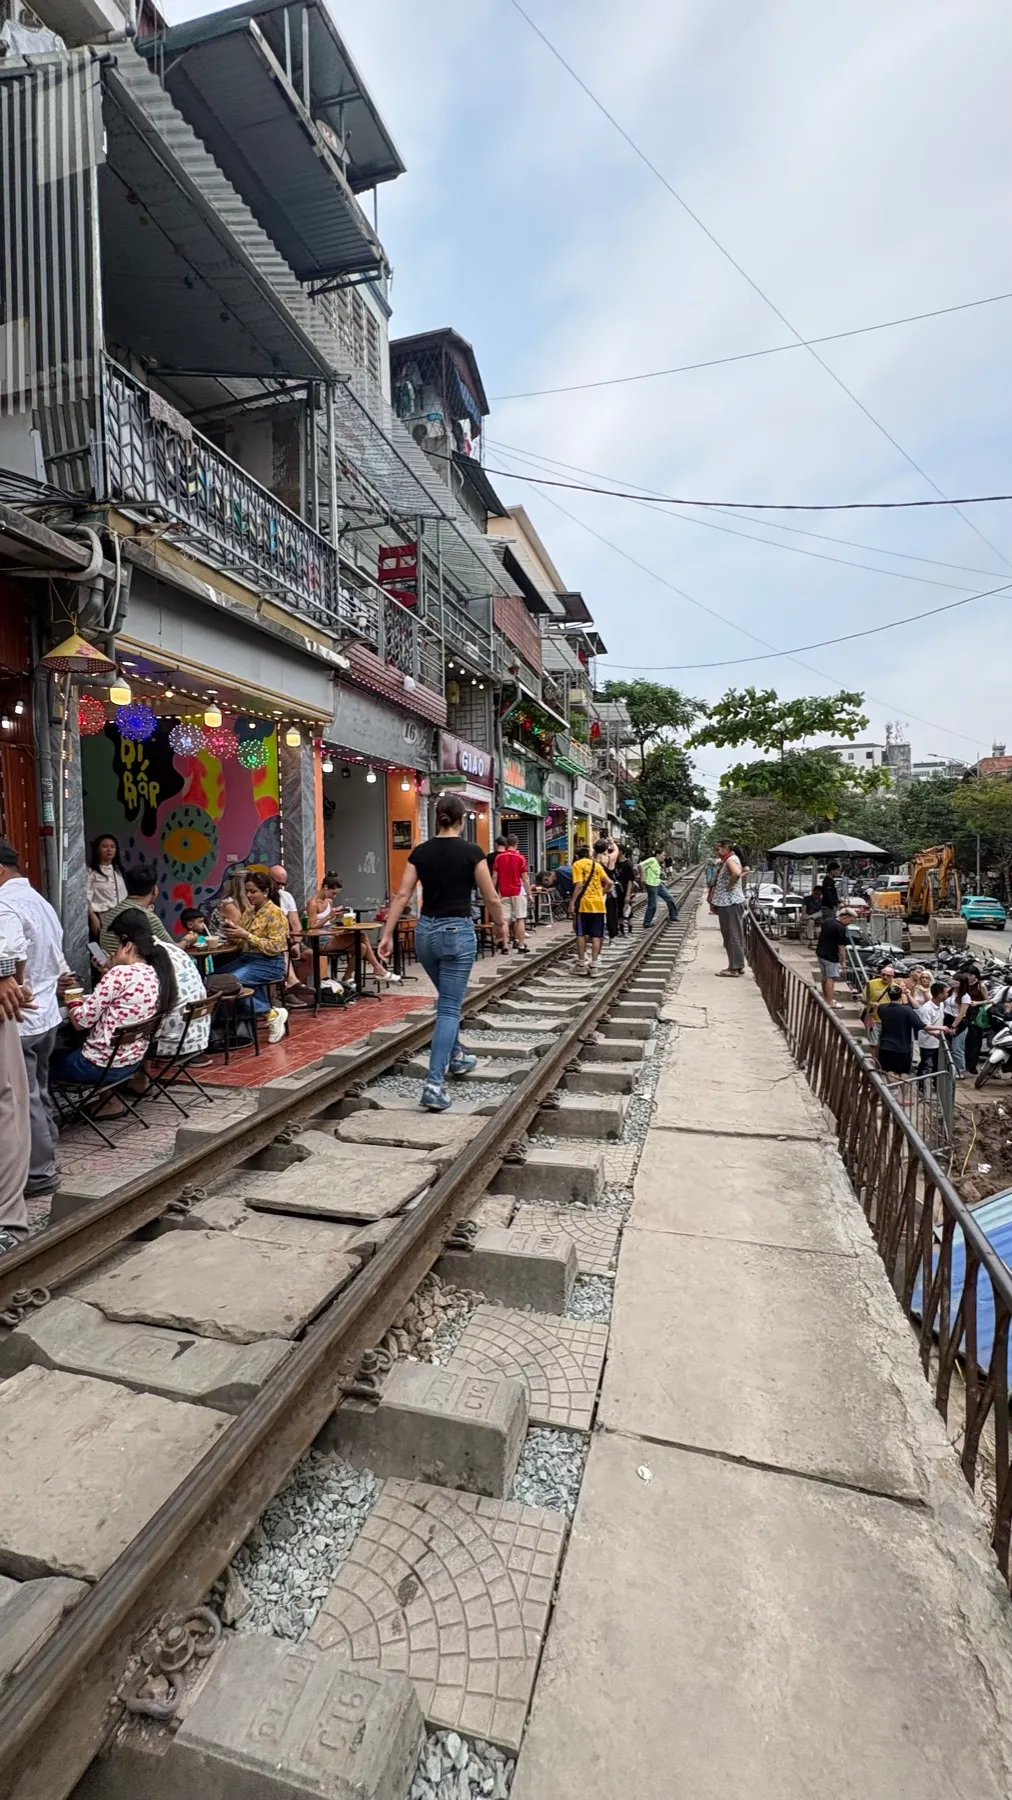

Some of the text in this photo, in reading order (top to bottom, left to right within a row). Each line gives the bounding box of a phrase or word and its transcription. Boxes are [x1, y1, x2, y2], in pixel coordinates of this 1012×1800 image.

[403, 721, 417, 742] 16
[461, 750, 484, 777] GIAO
[464, 1384, 489, 1410] CT6
